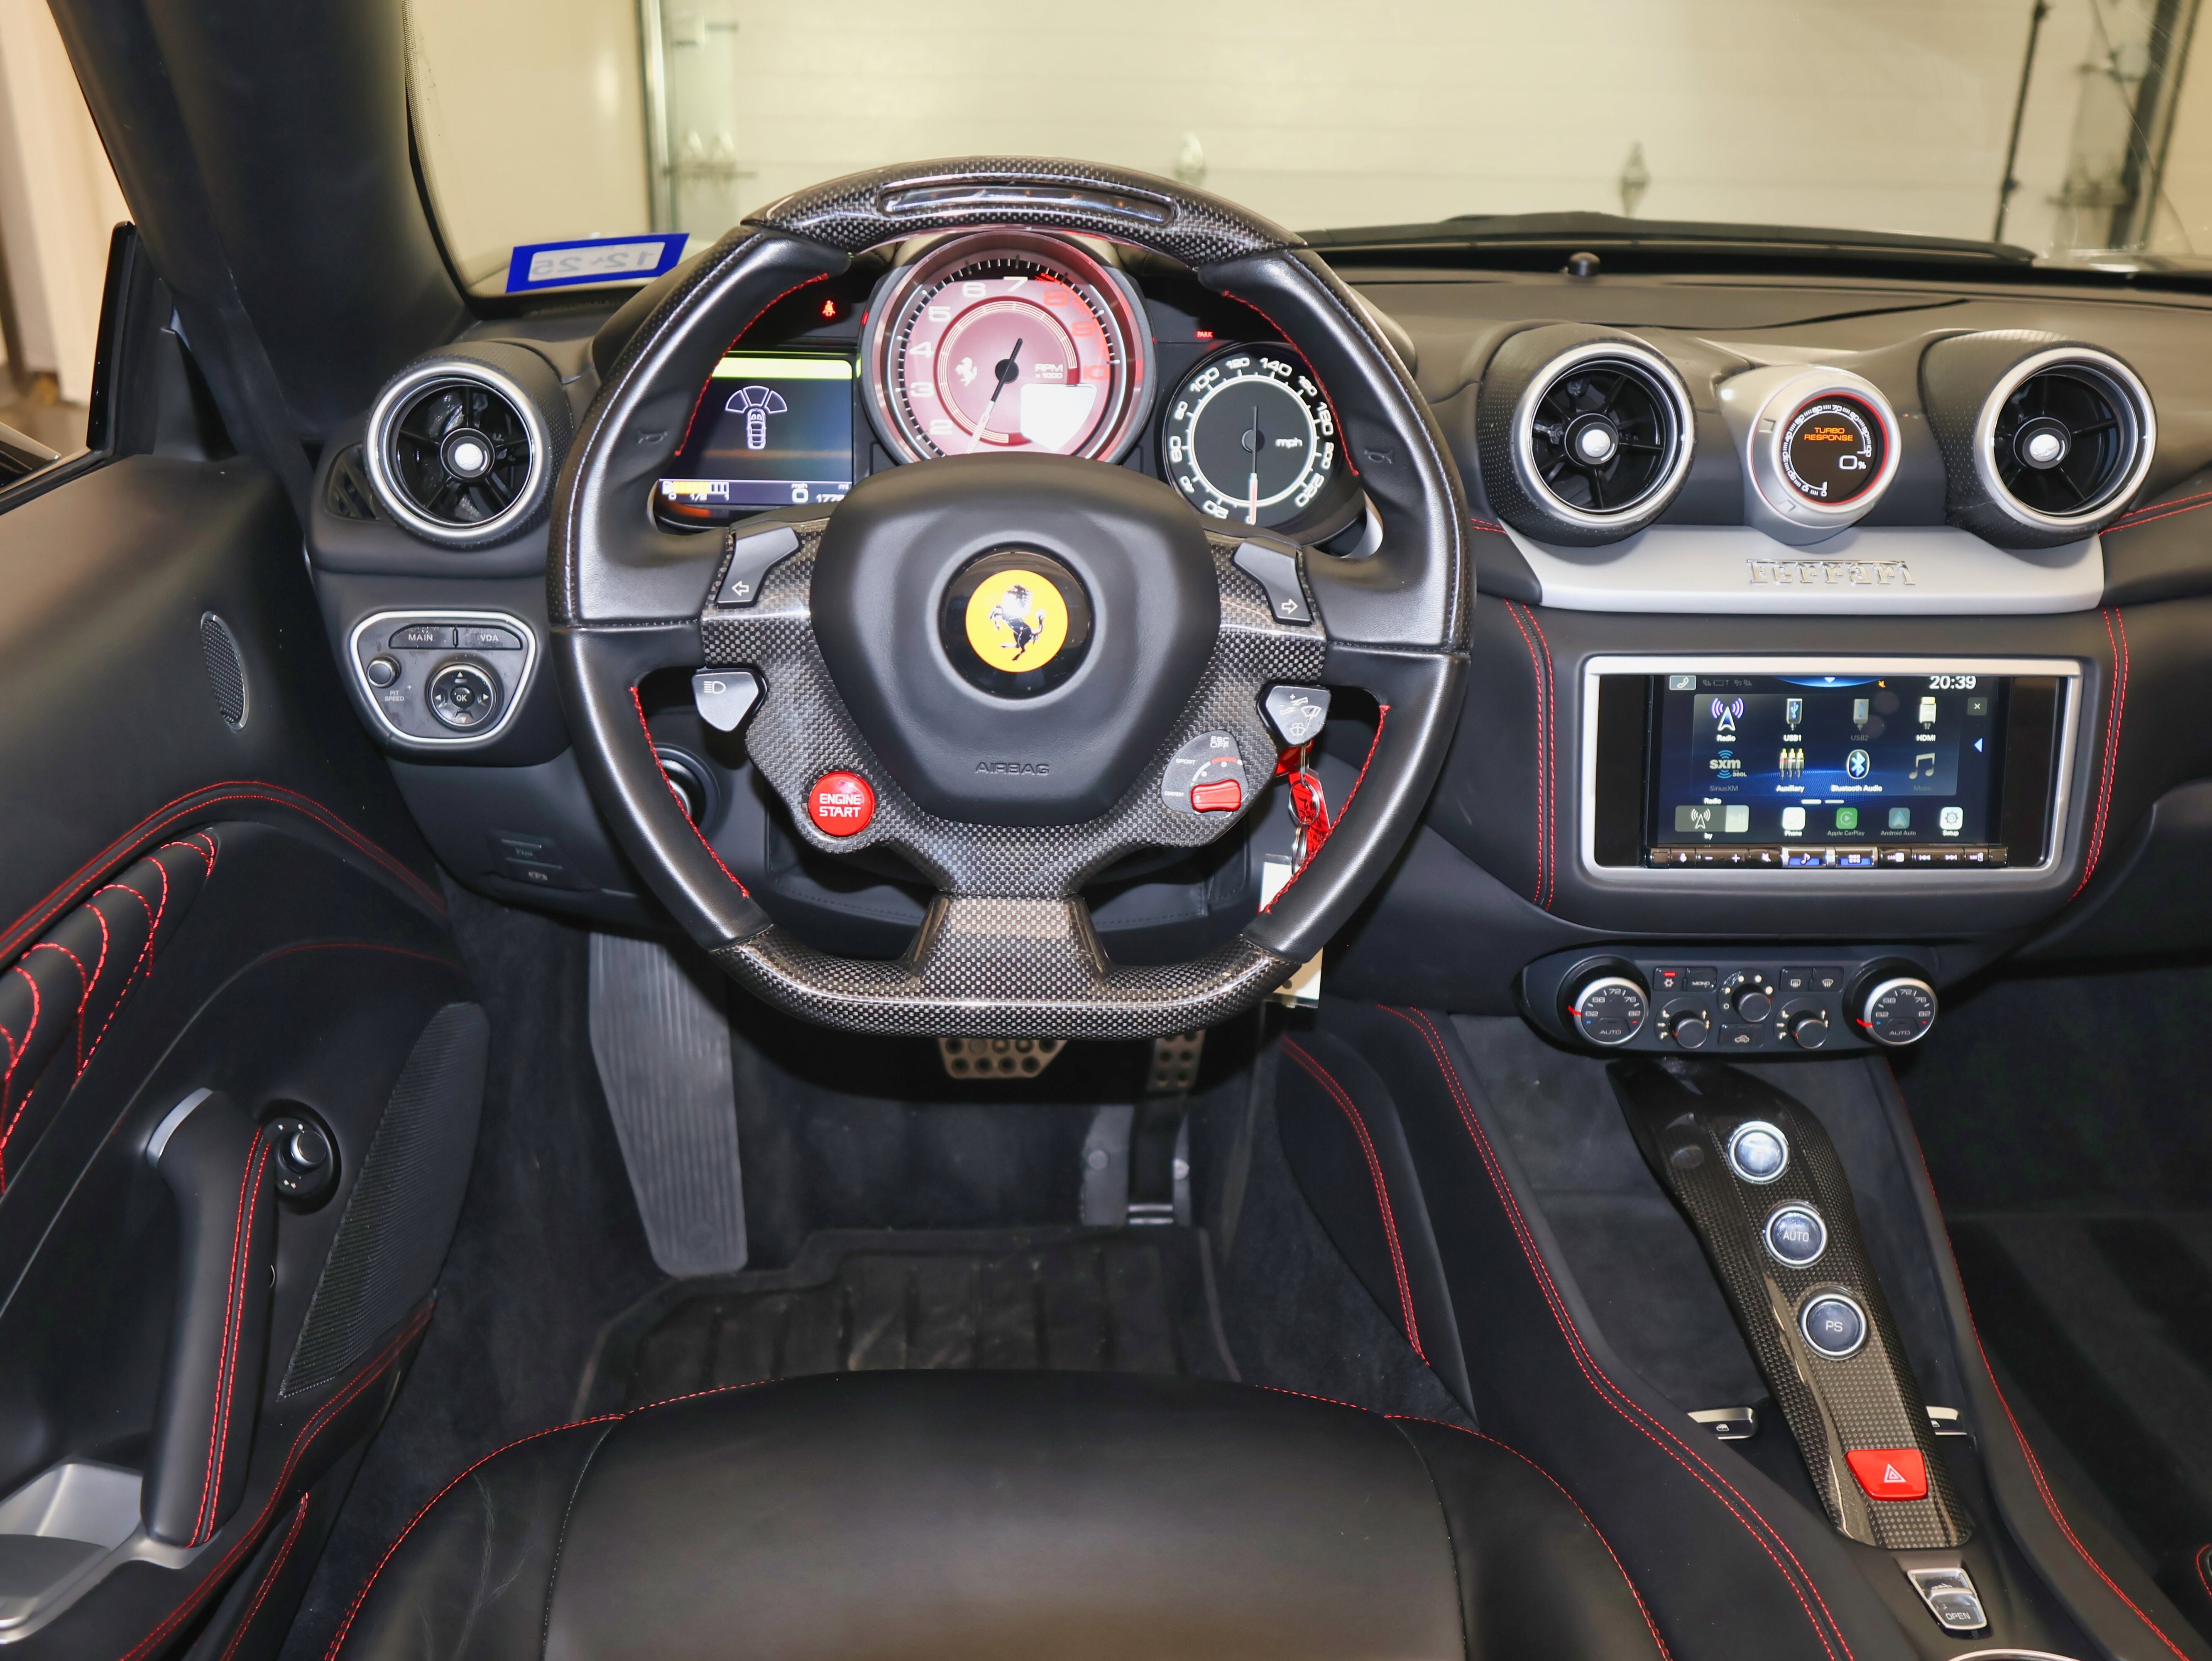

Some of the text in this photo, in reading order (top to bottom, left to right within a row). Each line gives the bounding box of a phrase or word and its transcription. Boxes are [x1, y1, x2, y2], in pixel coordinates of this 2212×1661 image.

[963, 282, 986, 297] 6
[1004, 276, 1028, 292] 7
[1044, 291, 1068, 306] 8
[928, 307, 952, 321] 5
[1071, 322, 1096, 337] 9
[909, 342, 934, 357] 4
[1226, 357, 1250, 369] 120
[1259, 358, 1292, 375] 140
[1083, 365, 1110, 380] 10
[1189, 367, 1219, 393] 100
[910, 382, 934, 397] 3
[1297, 375, 1318, 397] 160
[1175, 401, 1188, 420] 80
[1317, 402, 1334, 436] 180
[930, 419, 952, 435] 2
[1170, 436, 1183, 463] 60
[1275, 437, 1303, 448] mph
[1321, 442, 1334, 469] 200
[1180, 475, 1195, 493] 40
[1294, 475, 1325, 507] 220
[792, 488, 809, 503] 0
[1203, 500, 1229, 519] 20
[1747, 559, 1916, 585] Ferrari
[1929, 676, 1976, 689] 20:39
[975, 762, 1050, 775] AIRBAG
[1710, 759, 1741, 769] sxm
[820, 793, 861, 805] ENGINE
[819, 806, 861, 817] START
[1783, 1230, 1809, 1242] AUTO
[1826, 1320, 1843, 1332] PS
